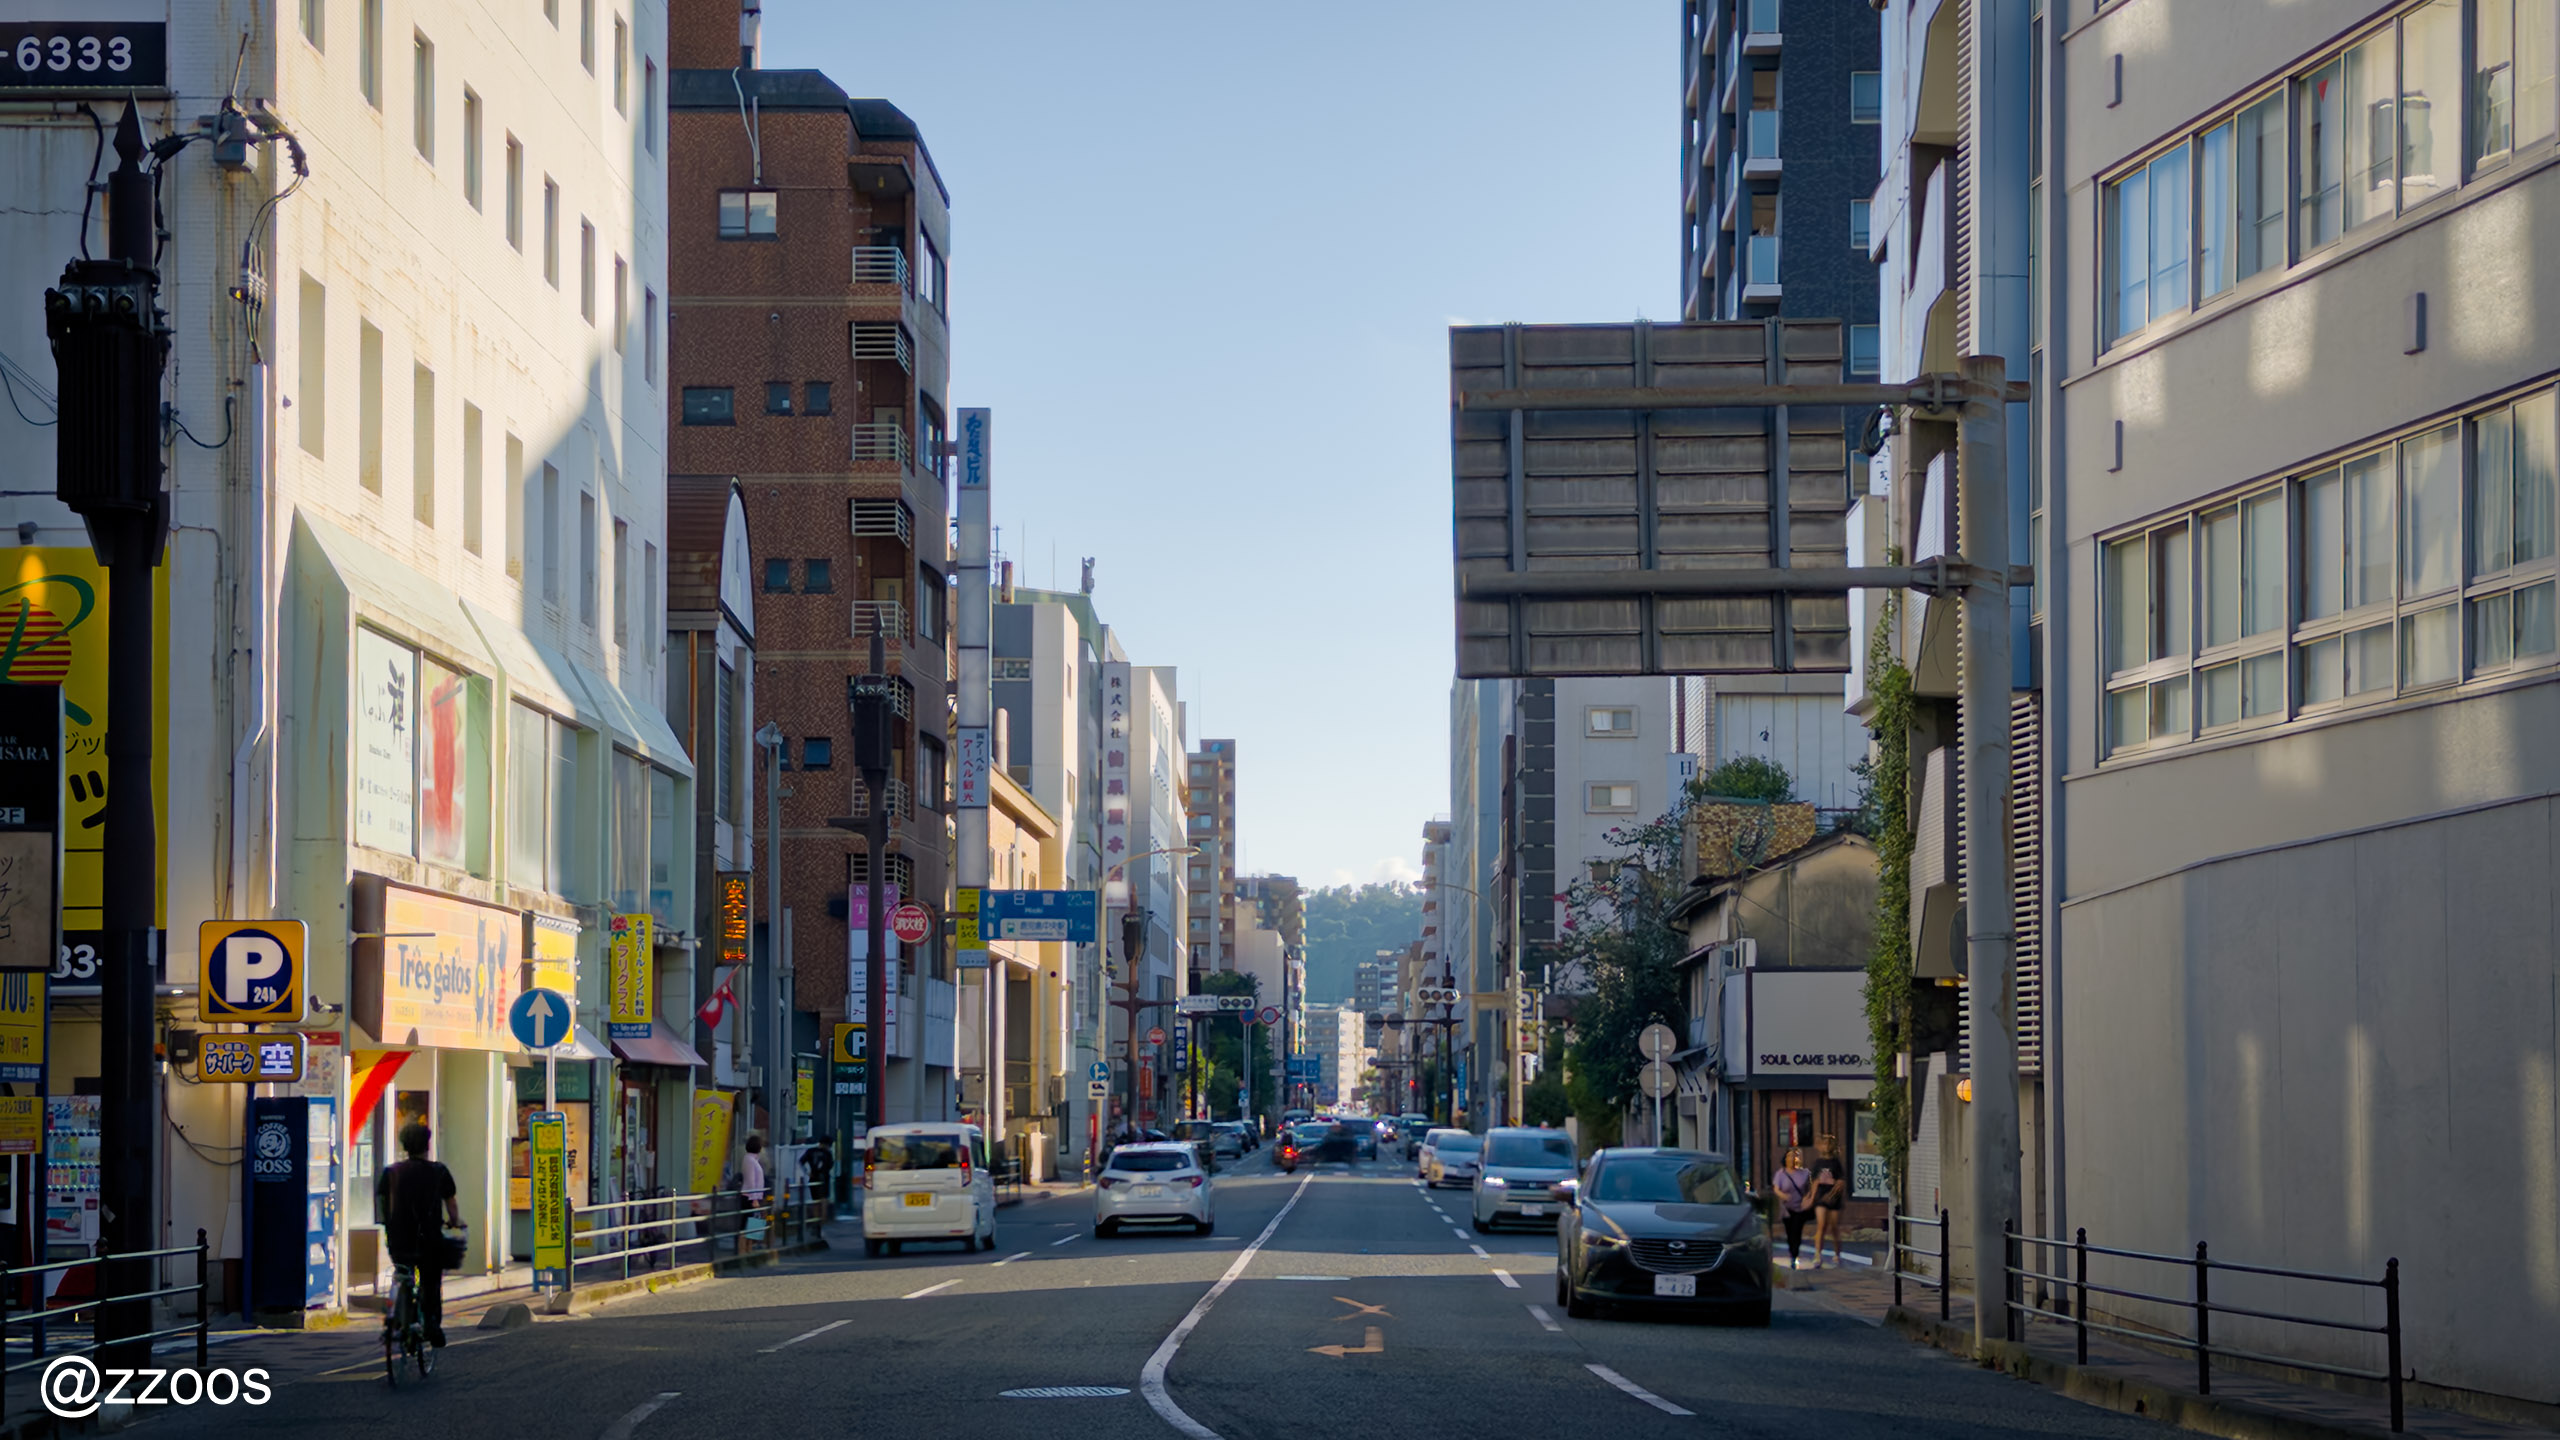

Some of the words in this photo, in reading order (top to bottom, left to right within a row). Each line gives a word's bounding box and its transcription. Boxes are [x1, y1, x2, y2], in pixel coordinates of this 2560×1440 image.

[1110, 676, 1122, 739] 株式会社
[895, 917, 925, 931] 消火栓
[226, 937, 284, 1003] P
[434, 953, 472, 1005] gatos
[617, 944, 629, 1015] ラリグラス
[253, 986, 277, 1003] 24h
[852, 1031, 867, 1055] P
[206, 1053, 255, 1075] ザ・パーク
[259, 1043, 294, 1074] 空
[1760, 1054, 1790, 1066] SOUL
[1793, 1054, 1824, 1066] CAKE
[1827, 1054, 1860, 1066] SHOP
[257, 1122, 289, 1137] COFFEE
[254, 1159, 293, 1174] BOSS
[1857, 1162, 1880, 1177] SOUL
[1857, 1176, 1881, 1190] SHOP
